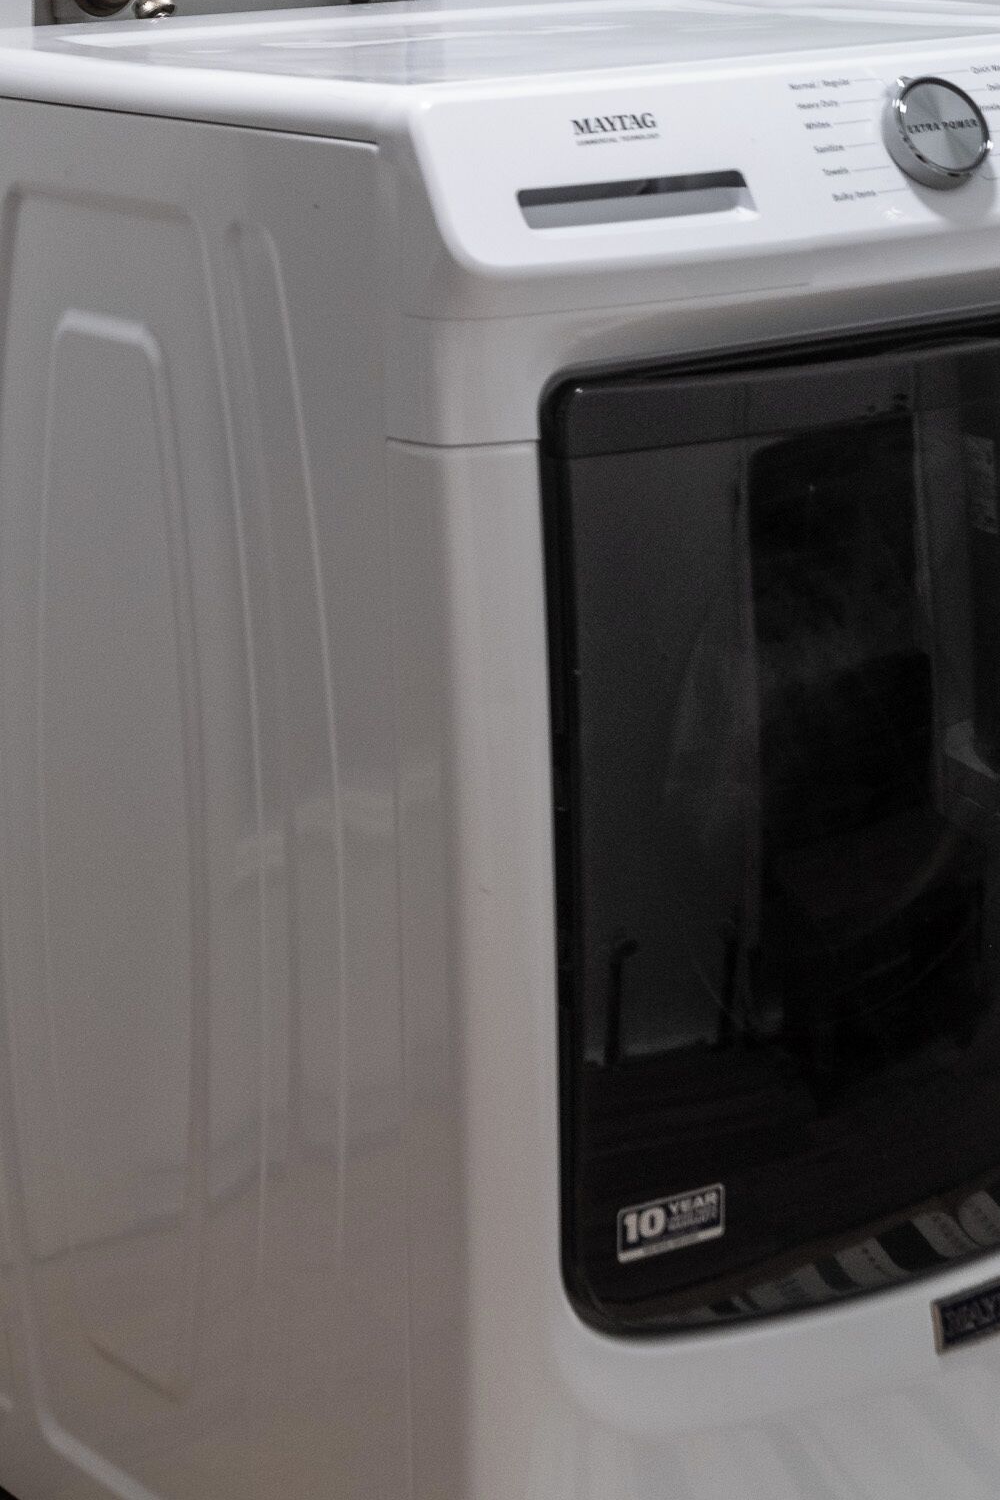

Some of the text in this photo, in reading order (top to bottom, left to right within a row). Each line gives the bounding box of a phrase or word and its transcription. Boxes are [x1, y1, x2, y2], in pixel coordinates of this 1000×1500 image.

[570, 112, 656, 135] MAYTAG
[906, 118, 978, 135] EXTRA POWER
[623, 1206, 667, 1244] 10
